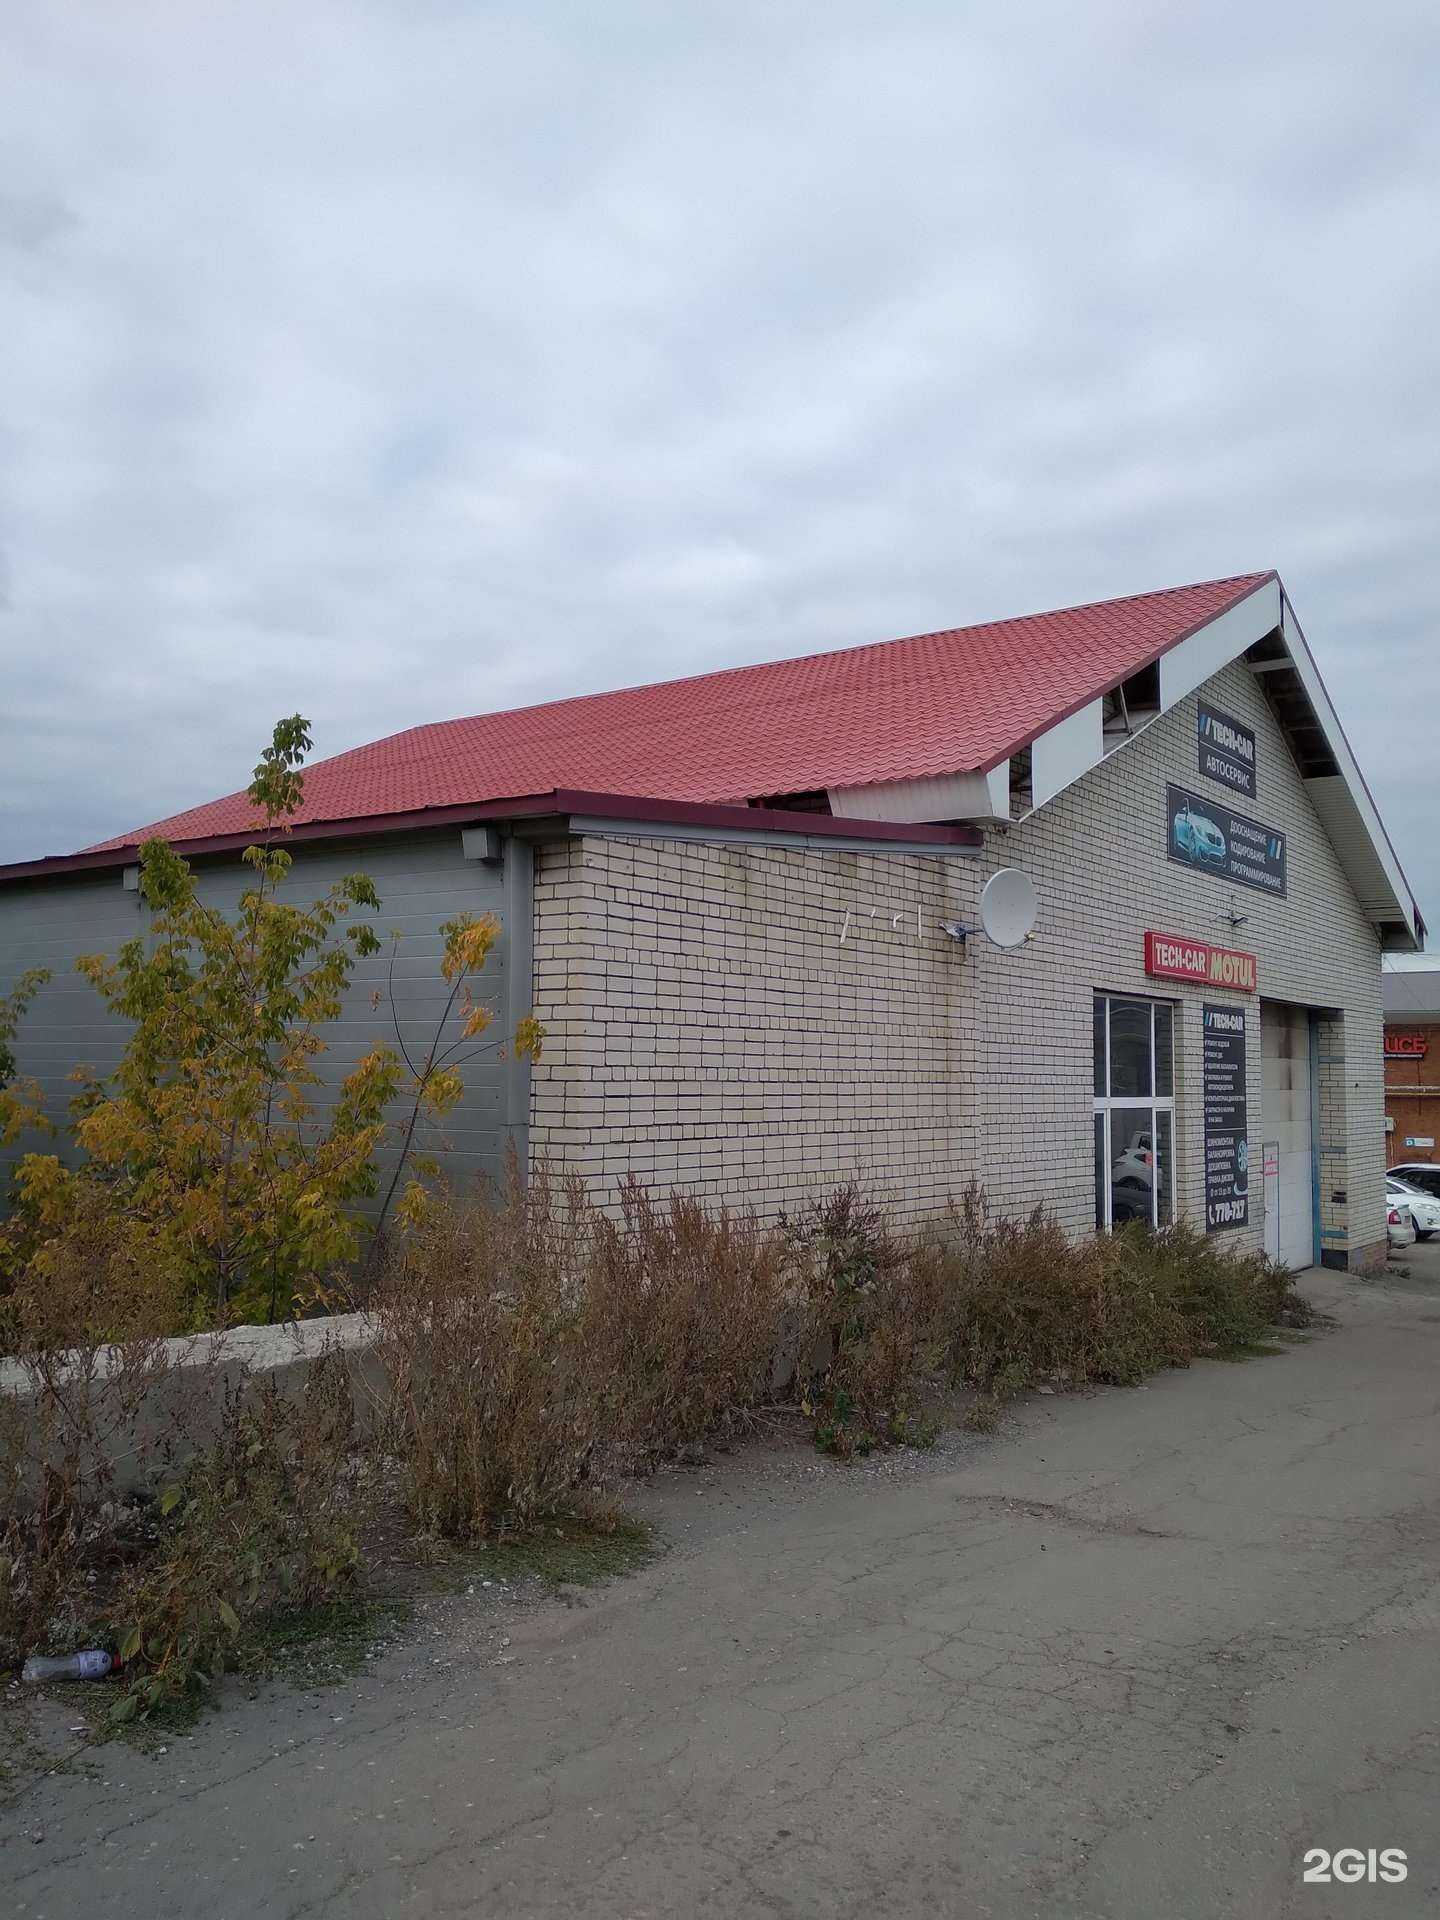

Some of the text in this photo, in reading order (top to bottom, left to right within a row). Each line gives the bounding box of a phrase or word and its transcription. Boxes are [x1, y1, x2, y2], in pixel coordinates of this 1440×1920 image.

[1212, 719, 1254, 761] TECH-CAR
[1206, 754, 1250, 789] АВТОСЕРВИС
[1230, 841, 1266, 864] КОДИРОВАНИЕ
[1230, 859, 1282, 888] ПРОГРАММИРОВАНИЕ
[1155, 943, 1255, 987] TECH-CAR MOTUL
